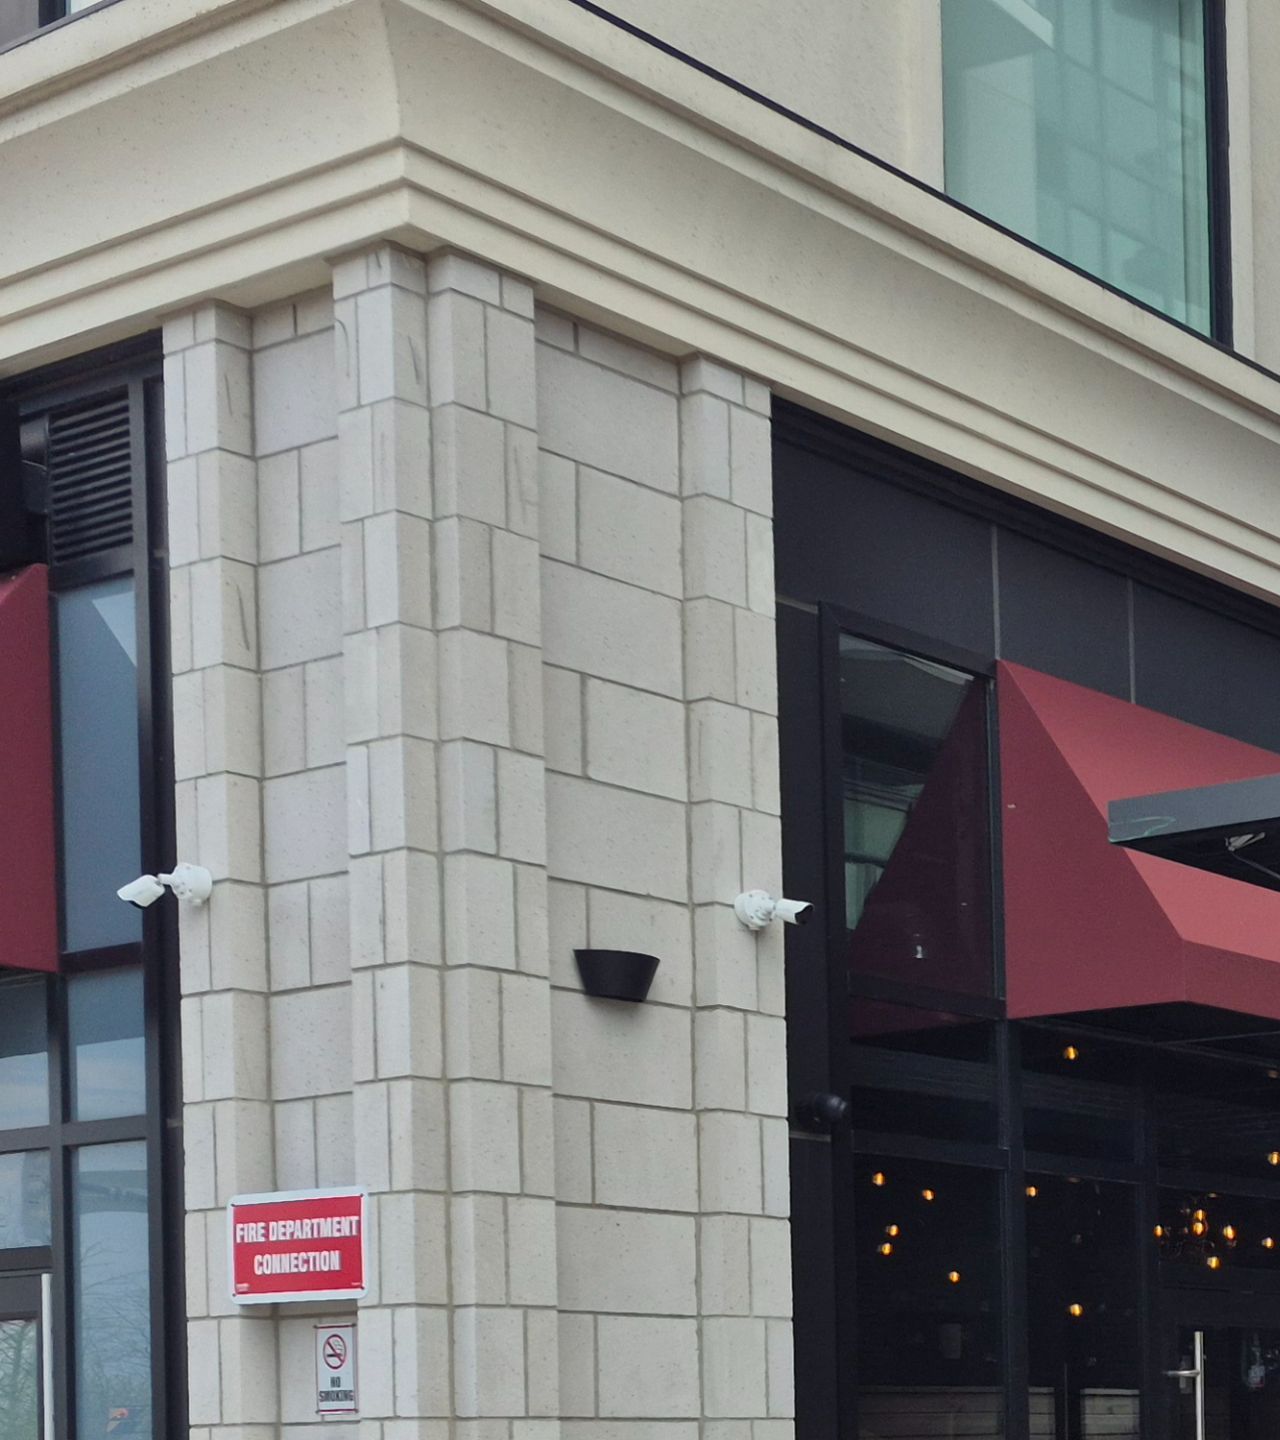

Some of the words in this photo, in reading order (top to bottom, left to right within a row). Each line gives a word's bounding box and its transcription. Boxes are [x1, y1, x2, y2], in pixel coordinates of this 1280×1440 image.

[236, 1222, 267, 1243] FIRE
[268, 1216, 360, 1241] DEPARTMENT
[254, 1250, 341, 1275] CONNECTION
[330, 1376, 341, 1388] NO
[319, 1390, 354, 1402] SMOKING
